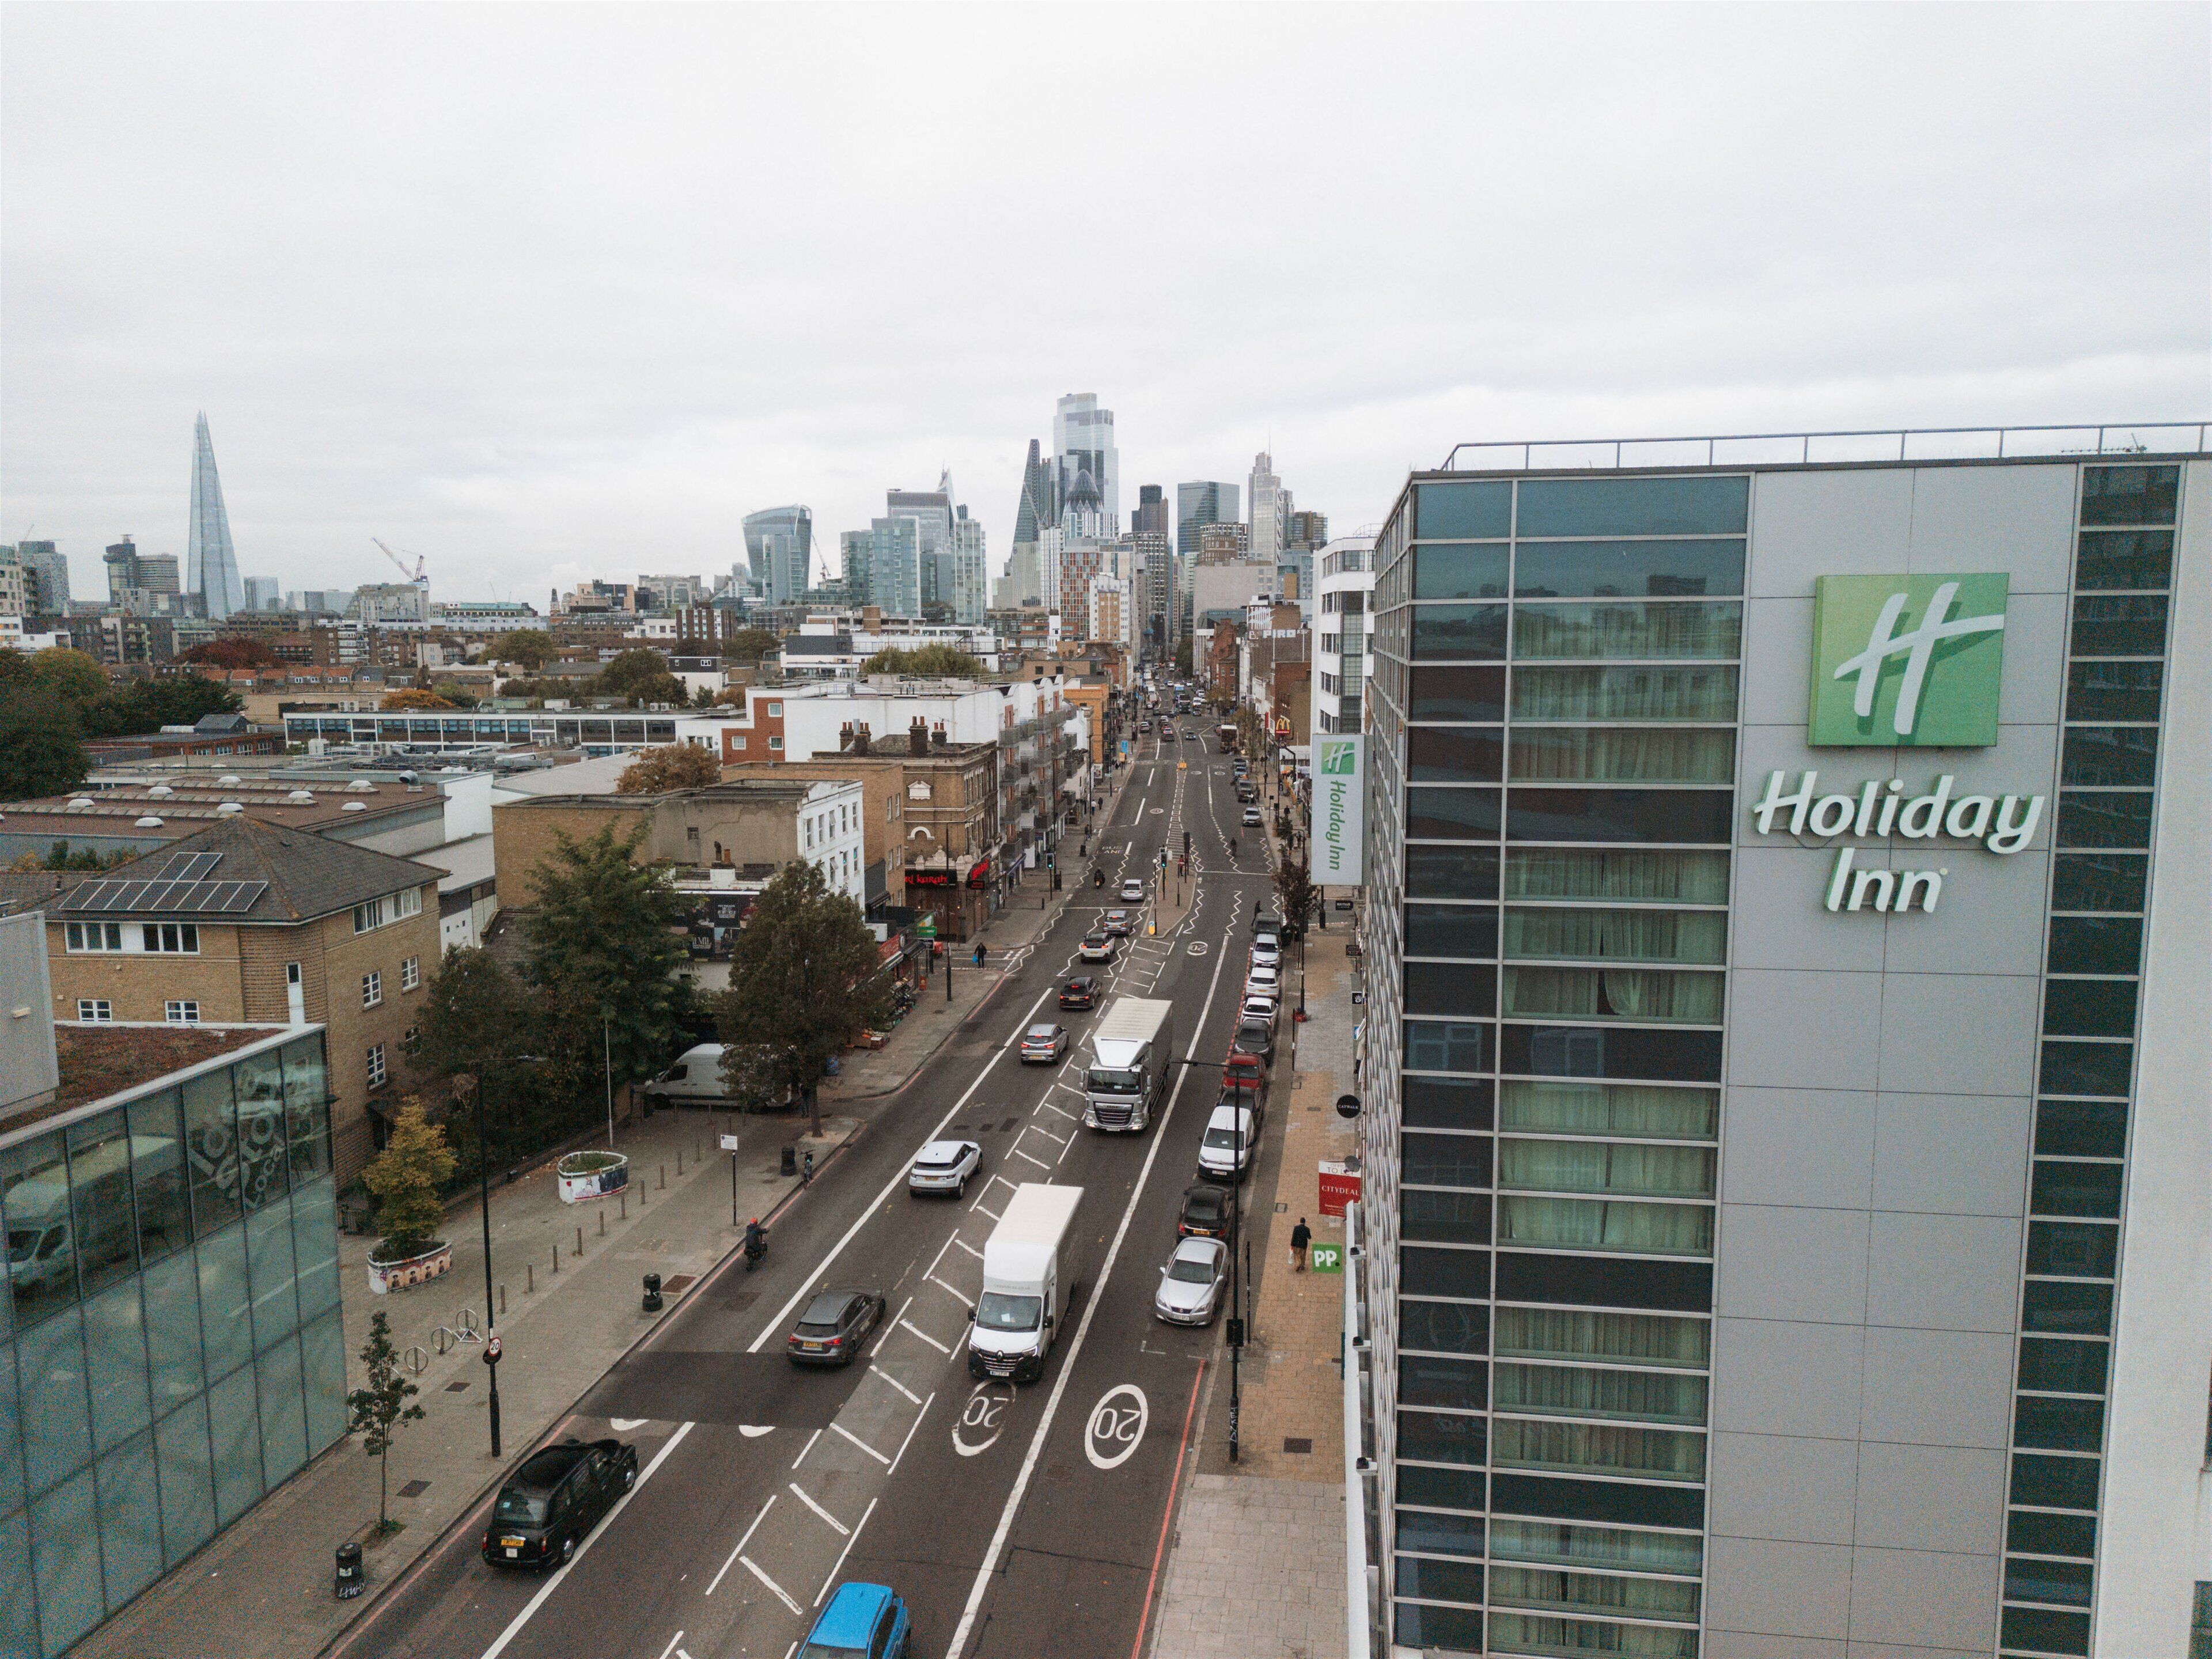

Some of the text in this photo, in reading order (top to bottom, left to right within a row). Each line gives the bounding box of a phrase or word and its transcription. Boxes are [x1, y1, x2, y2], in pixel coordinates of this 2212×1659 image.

[1325, 780, 1346, 870] Holiday Inn
[1754, 771, 2044, 854] Holiday
[1825, 847, 1943, 912] Inn
[1321, 1185, 1359, 1196] CITYDEAL
[491, 1342, 499, 1350] 20
[963, 1396, 1010, 1428] 20
[1095, 1408, 1142, 1441] 20
